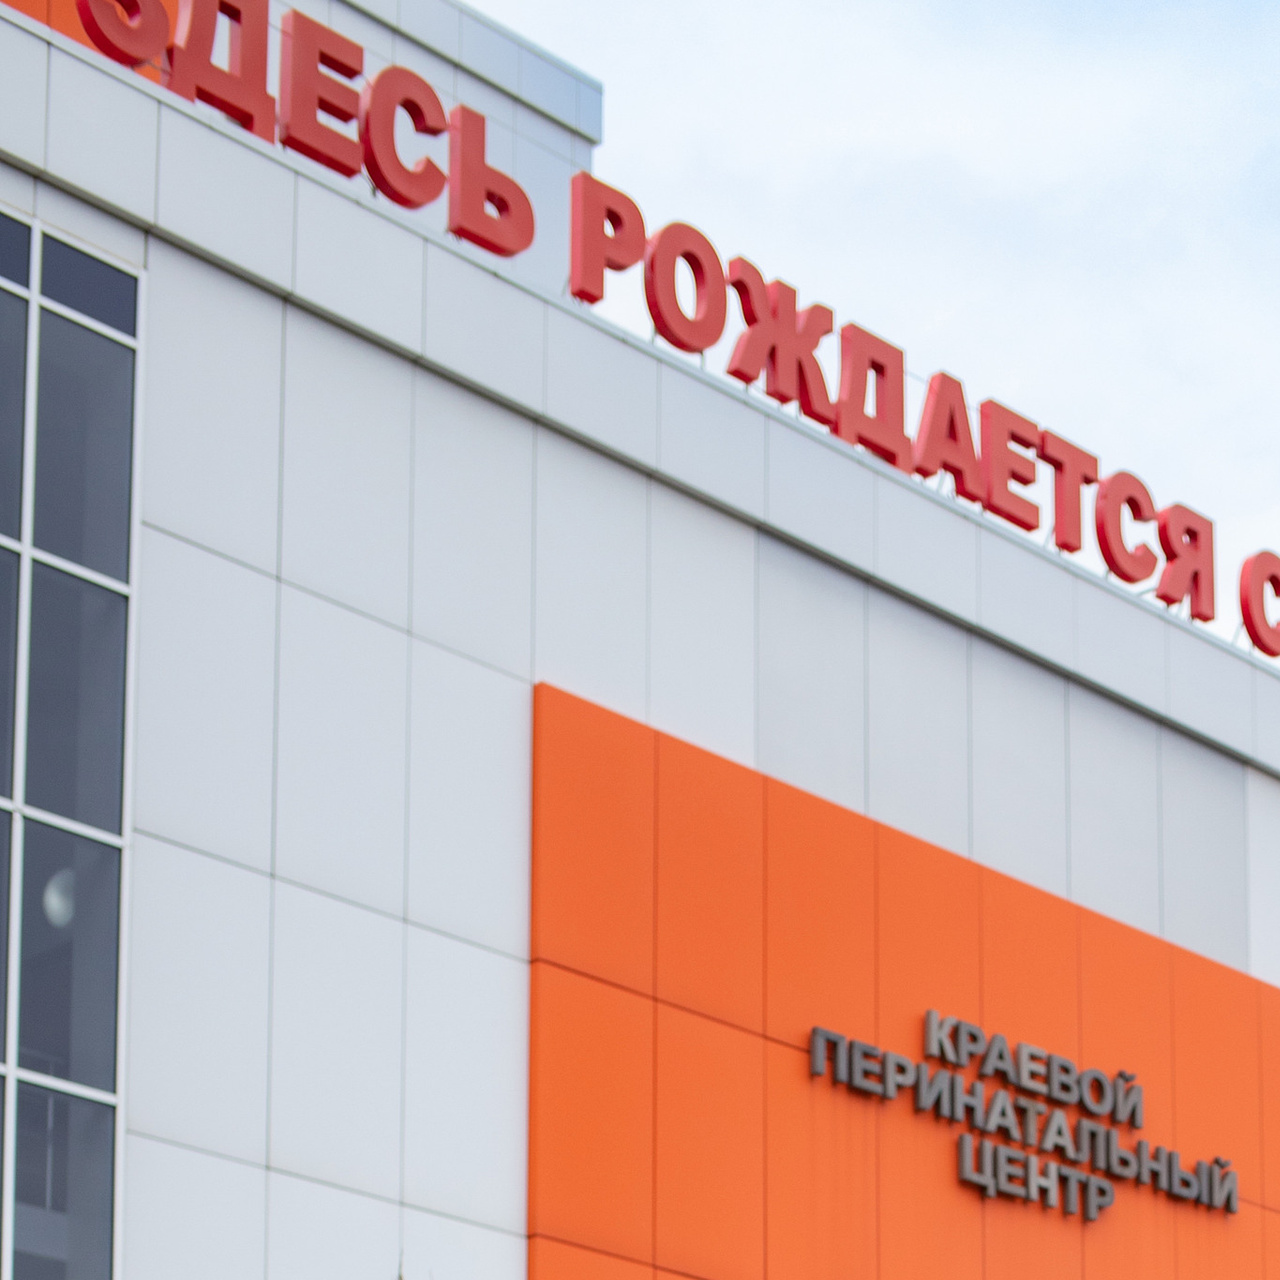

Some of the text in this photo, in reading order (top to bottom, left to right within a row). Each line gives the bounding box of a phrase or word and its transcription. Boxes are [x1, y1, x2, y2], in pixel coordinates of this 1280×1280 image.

[569, 171, 1215, 622] РОЖДАЕТСЯ
[809, 1027, 1239, 1214] ПЕРИНАТАЛЬНЫЙ
[926, 1009, 1144, 1129] КРАЕВОЙ
[958, 1133, 1115, 1221] ЦЕНТР
